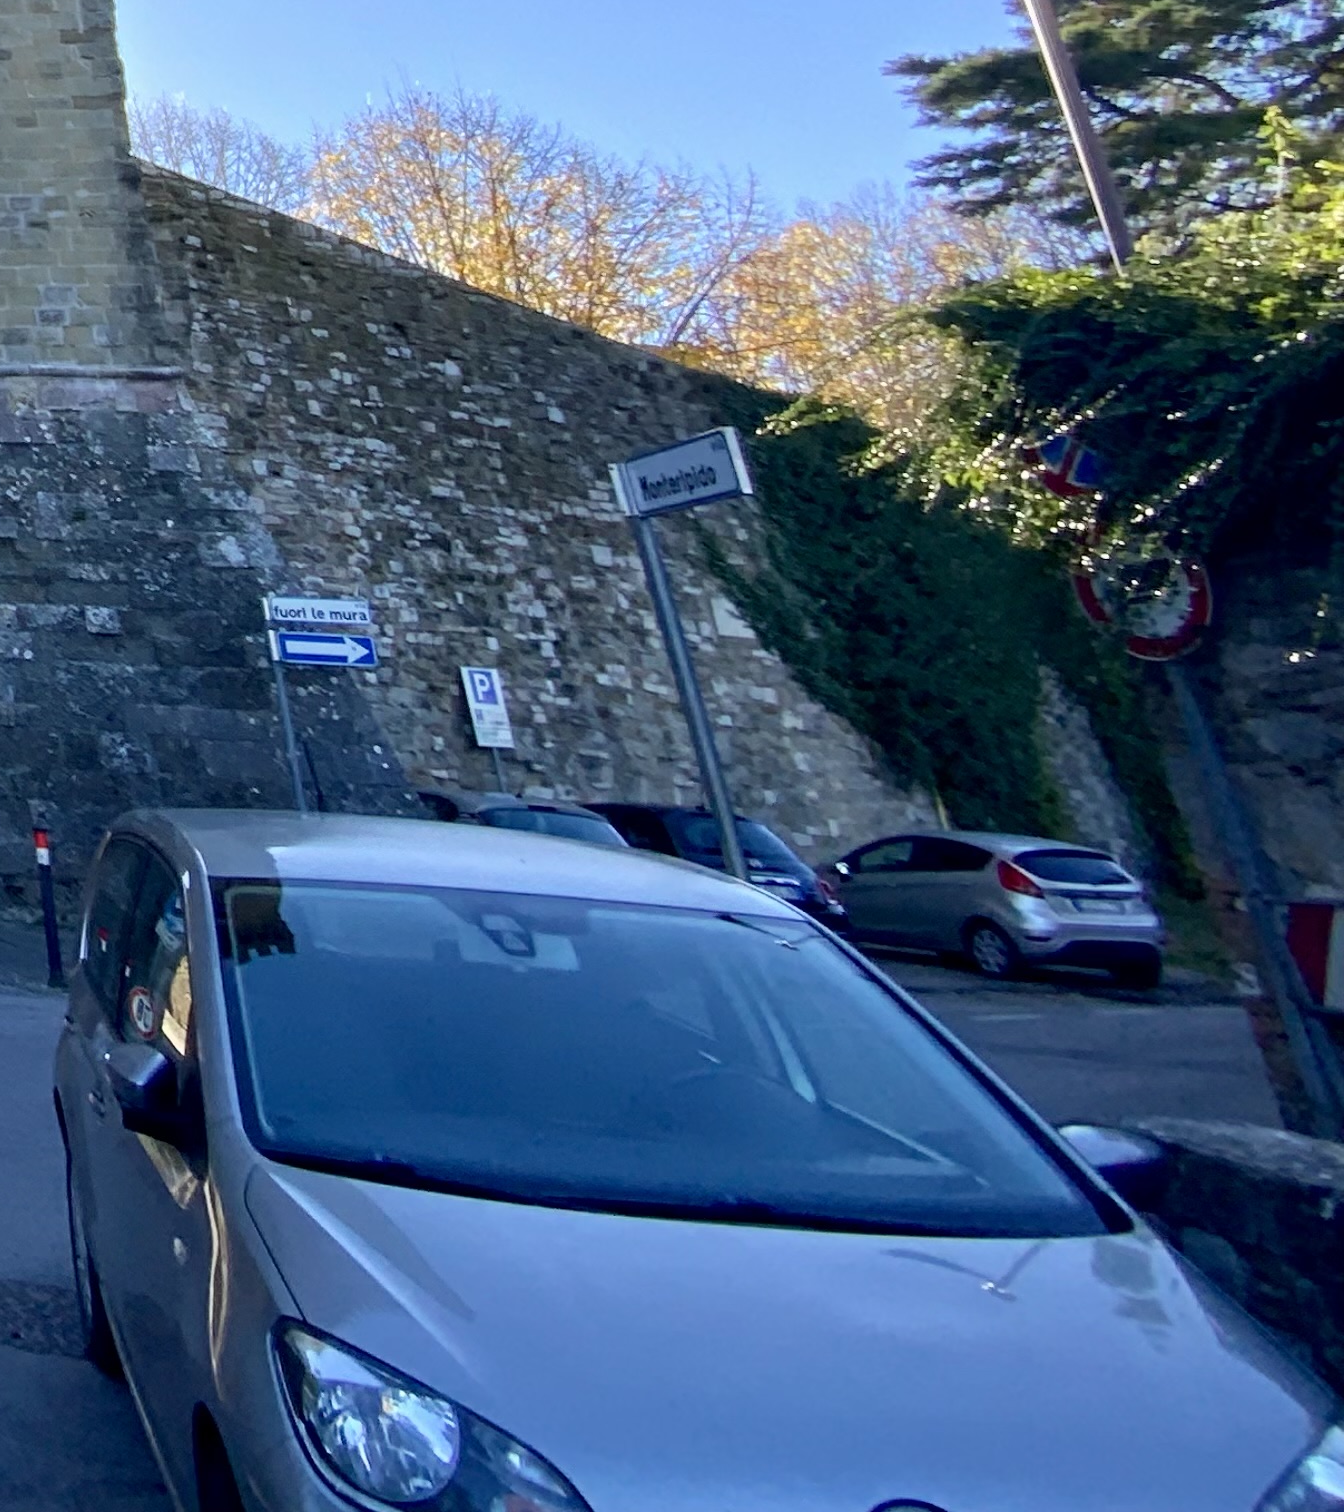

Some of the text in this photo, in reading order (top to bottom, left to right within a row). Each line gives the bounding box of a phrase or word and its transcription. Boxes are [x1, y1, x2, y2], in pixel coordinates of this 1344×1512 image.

[638, 464, 717, 502] Monteripido
[273, 605, 369, 621] fuori le mura
[472, 672, 491, 701] P
